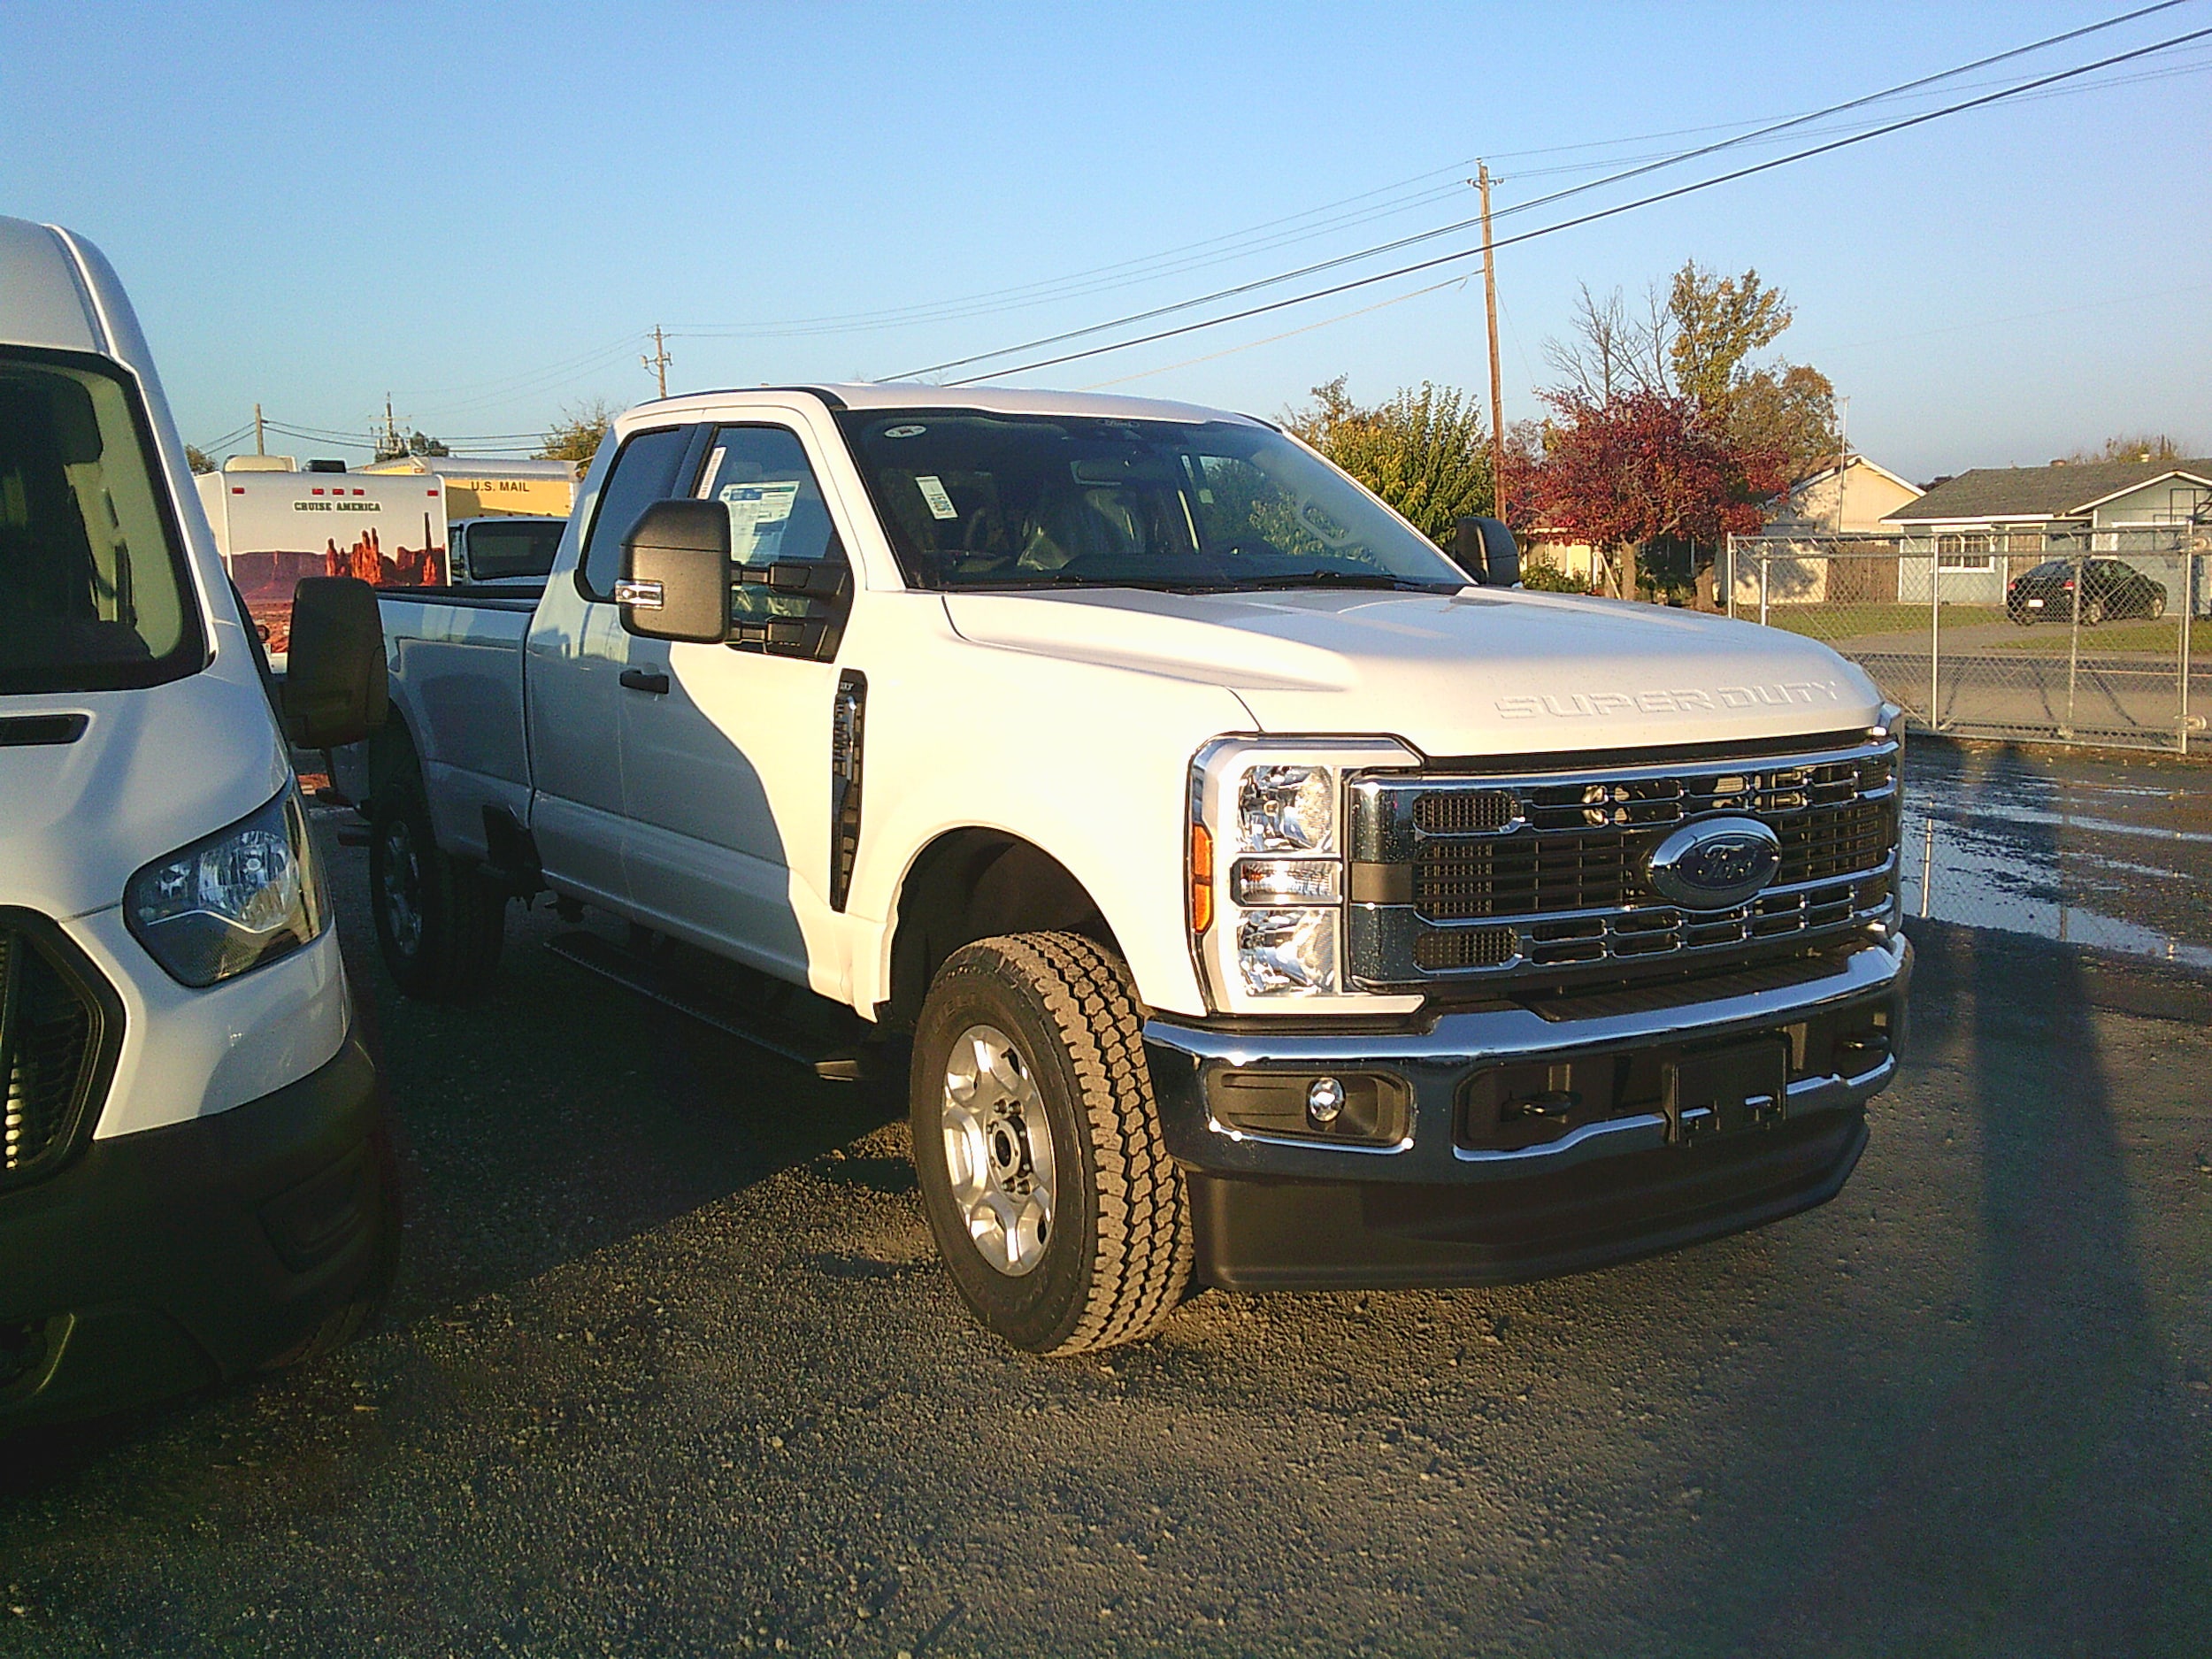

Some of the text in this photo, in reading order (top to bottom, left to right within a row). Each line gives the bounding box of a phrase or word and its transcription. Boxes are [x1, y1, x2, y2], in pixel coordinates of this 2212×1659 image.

[471, 481, 530, 493] U.S. MAIL
[294, 502, 381, 512] CRUISE AMERICA
[1494, 680, 1839, 719] SUPER DUTY
